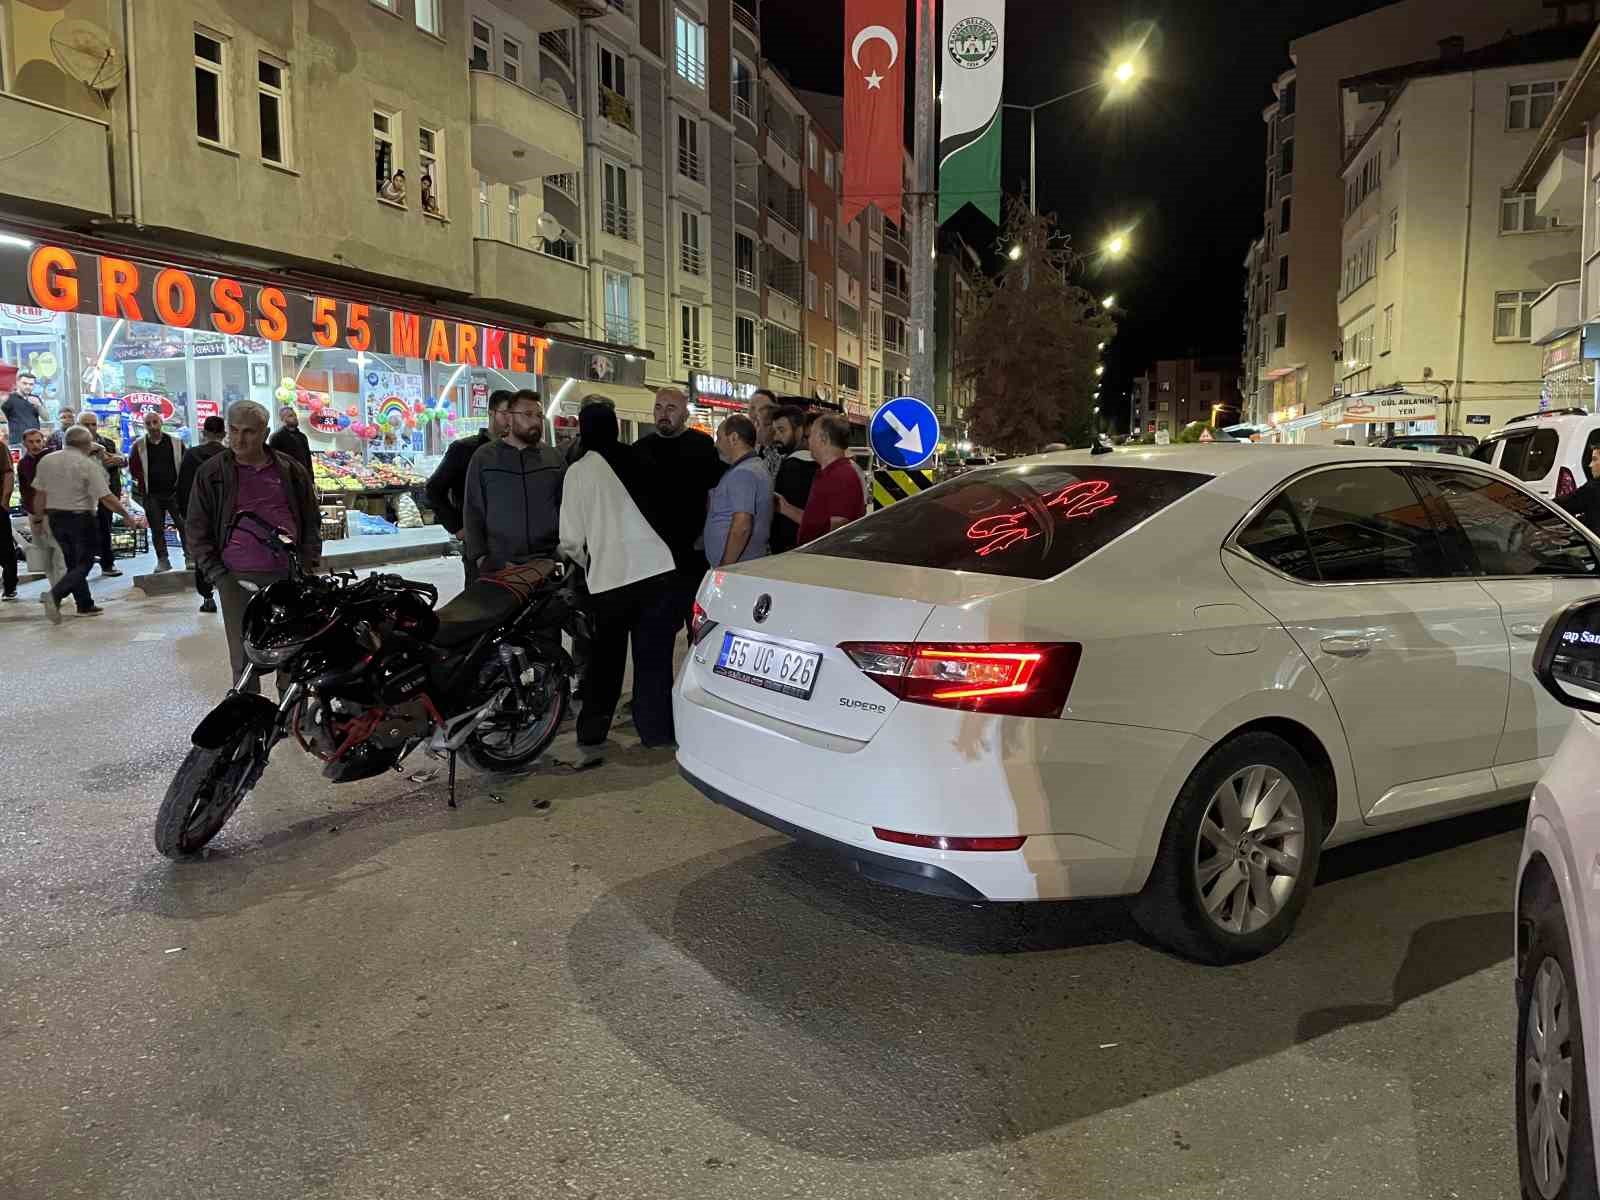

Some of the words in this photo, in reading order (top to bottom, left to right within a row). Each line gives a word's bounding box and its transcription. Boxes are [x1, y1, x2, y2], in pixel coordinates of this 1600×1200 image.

[27, 245, 288, 341] GROSS
[312, 296, 371, 352] 55
[391, 310, 549, 376] MARKET
[139, 404, 154, 414] 55
[729, 640, 750, 668] 55
[753, 647, 775, 675] UC
[780, 652, 814, 686] 626
[839, 697, 886, 713] SUPERB
